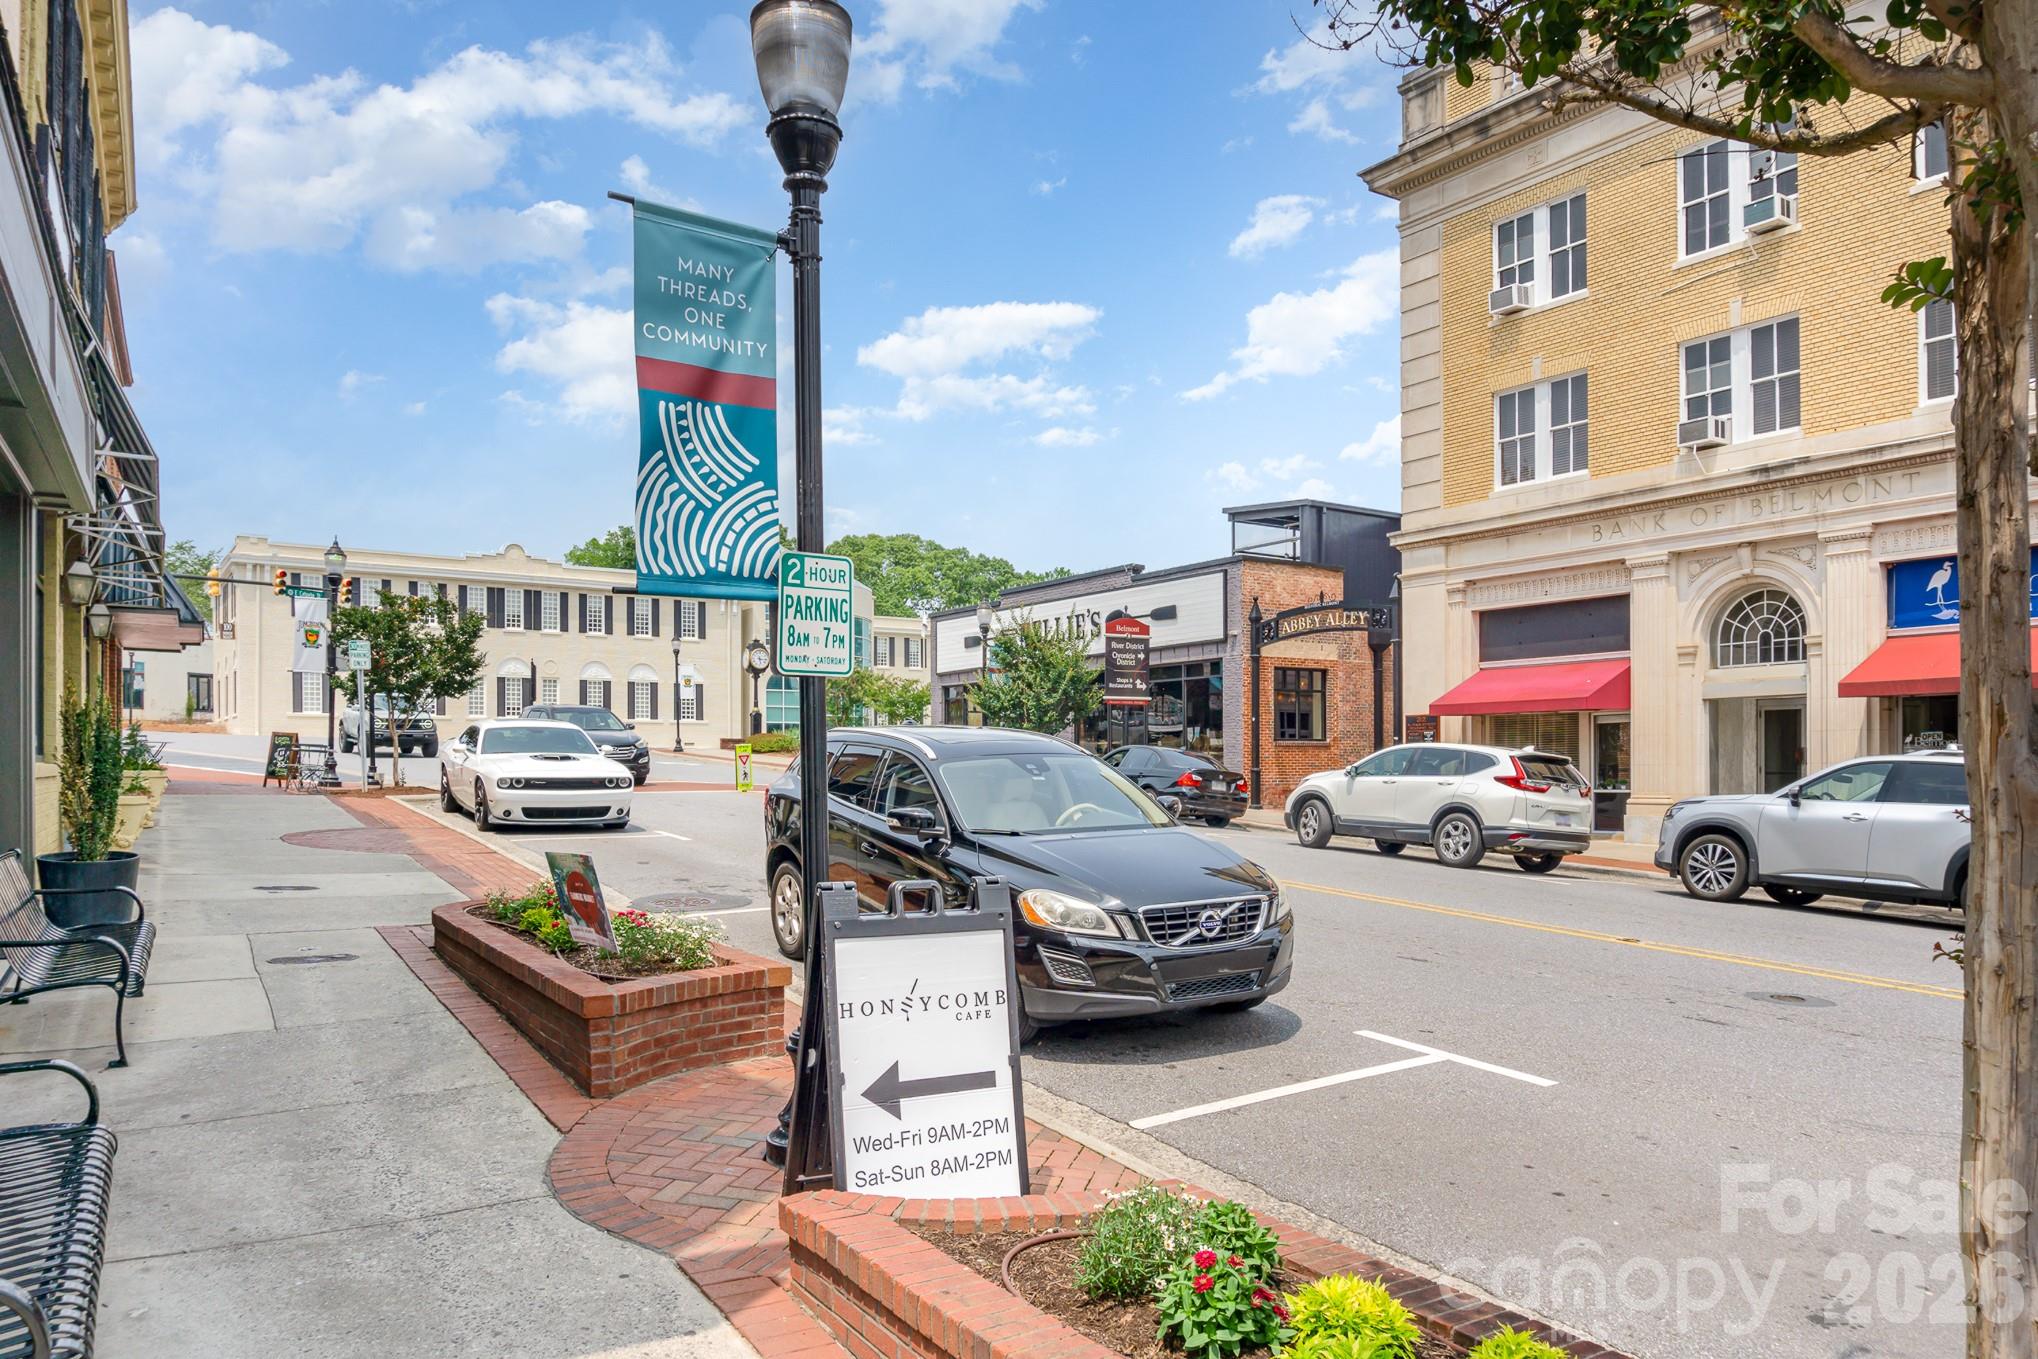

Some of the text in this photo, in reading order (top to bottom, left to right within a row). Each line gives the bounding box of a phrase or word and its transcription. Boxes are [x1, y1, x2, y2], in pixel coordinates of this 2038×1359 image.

[678, 256, 734, 283] MANY
[657, 275, 752, 312] THREADS,
[684, 307, 726, 329] ONE
[642, 322, 767, 358] COMMUNITY
[1591, 471, 1921, 543] BANK OF BELMONT
[786, 557, 847, 584] 2 HOUR
[784, 594, 849, 624] PARKING
[1281, 610, 1367, 634] ABBEY ALLEY
[1115, 624, 1139, 633] Belmont
[785, 655, 810, 663] MONDAY
[1111, 641, 1144, 650] River District
[1116, 658, 1136, 666] District
[955, 1009, 992, 1022] CAFE
[852, 1117, 1010, 1155] Wed-Fri 9AM-2PM
[855, 1149, 1012, 1188] Sat-Sun 8AM-2PM
